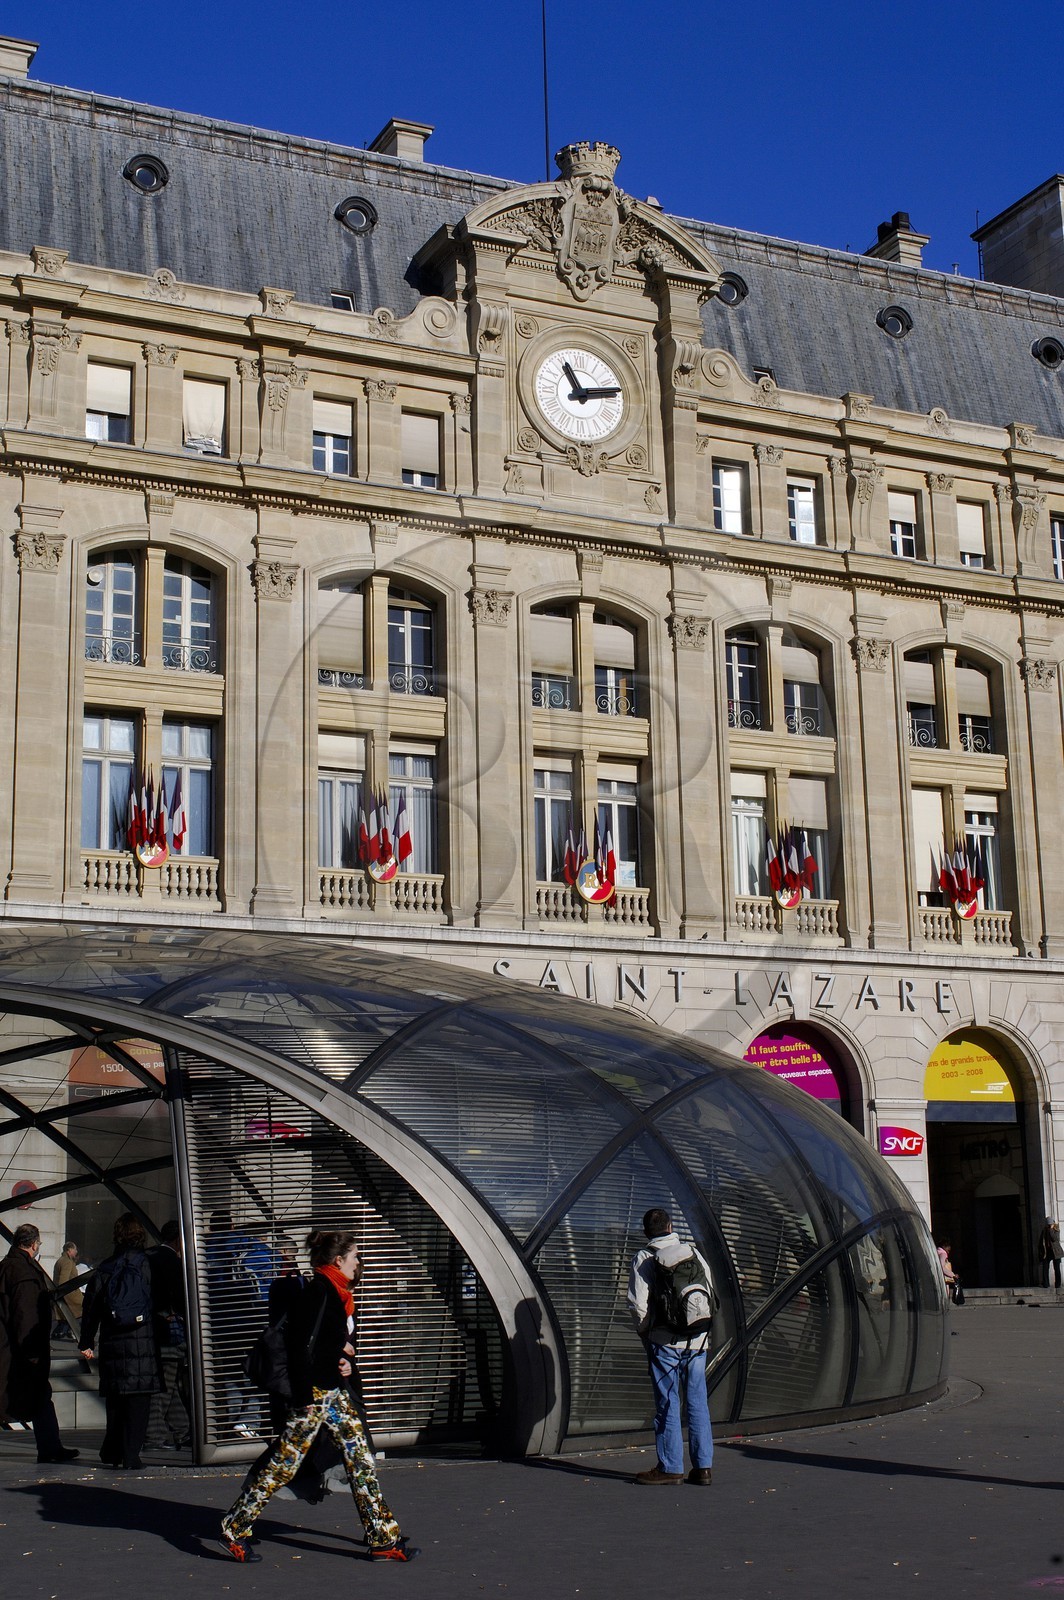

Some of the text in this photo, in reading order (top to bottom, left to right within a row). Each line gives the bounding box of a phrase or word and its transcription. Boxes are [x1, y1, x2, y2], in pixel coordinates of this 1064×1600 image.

[735, 971, 954, 1014] LAZARE
[759, 1045, 778, 1055] faut
[769, 1057, 789, 1067] être
[791, 1055, 811, 1065] belle
[940, 1057, 949, 1066] de
[950, 1054, 975, 1067] grands
[101, 1063, 124, 1073] 1500
[941, 1070, 959, 1079] 2003
[883, 1136, 923, 1151] SNCF
